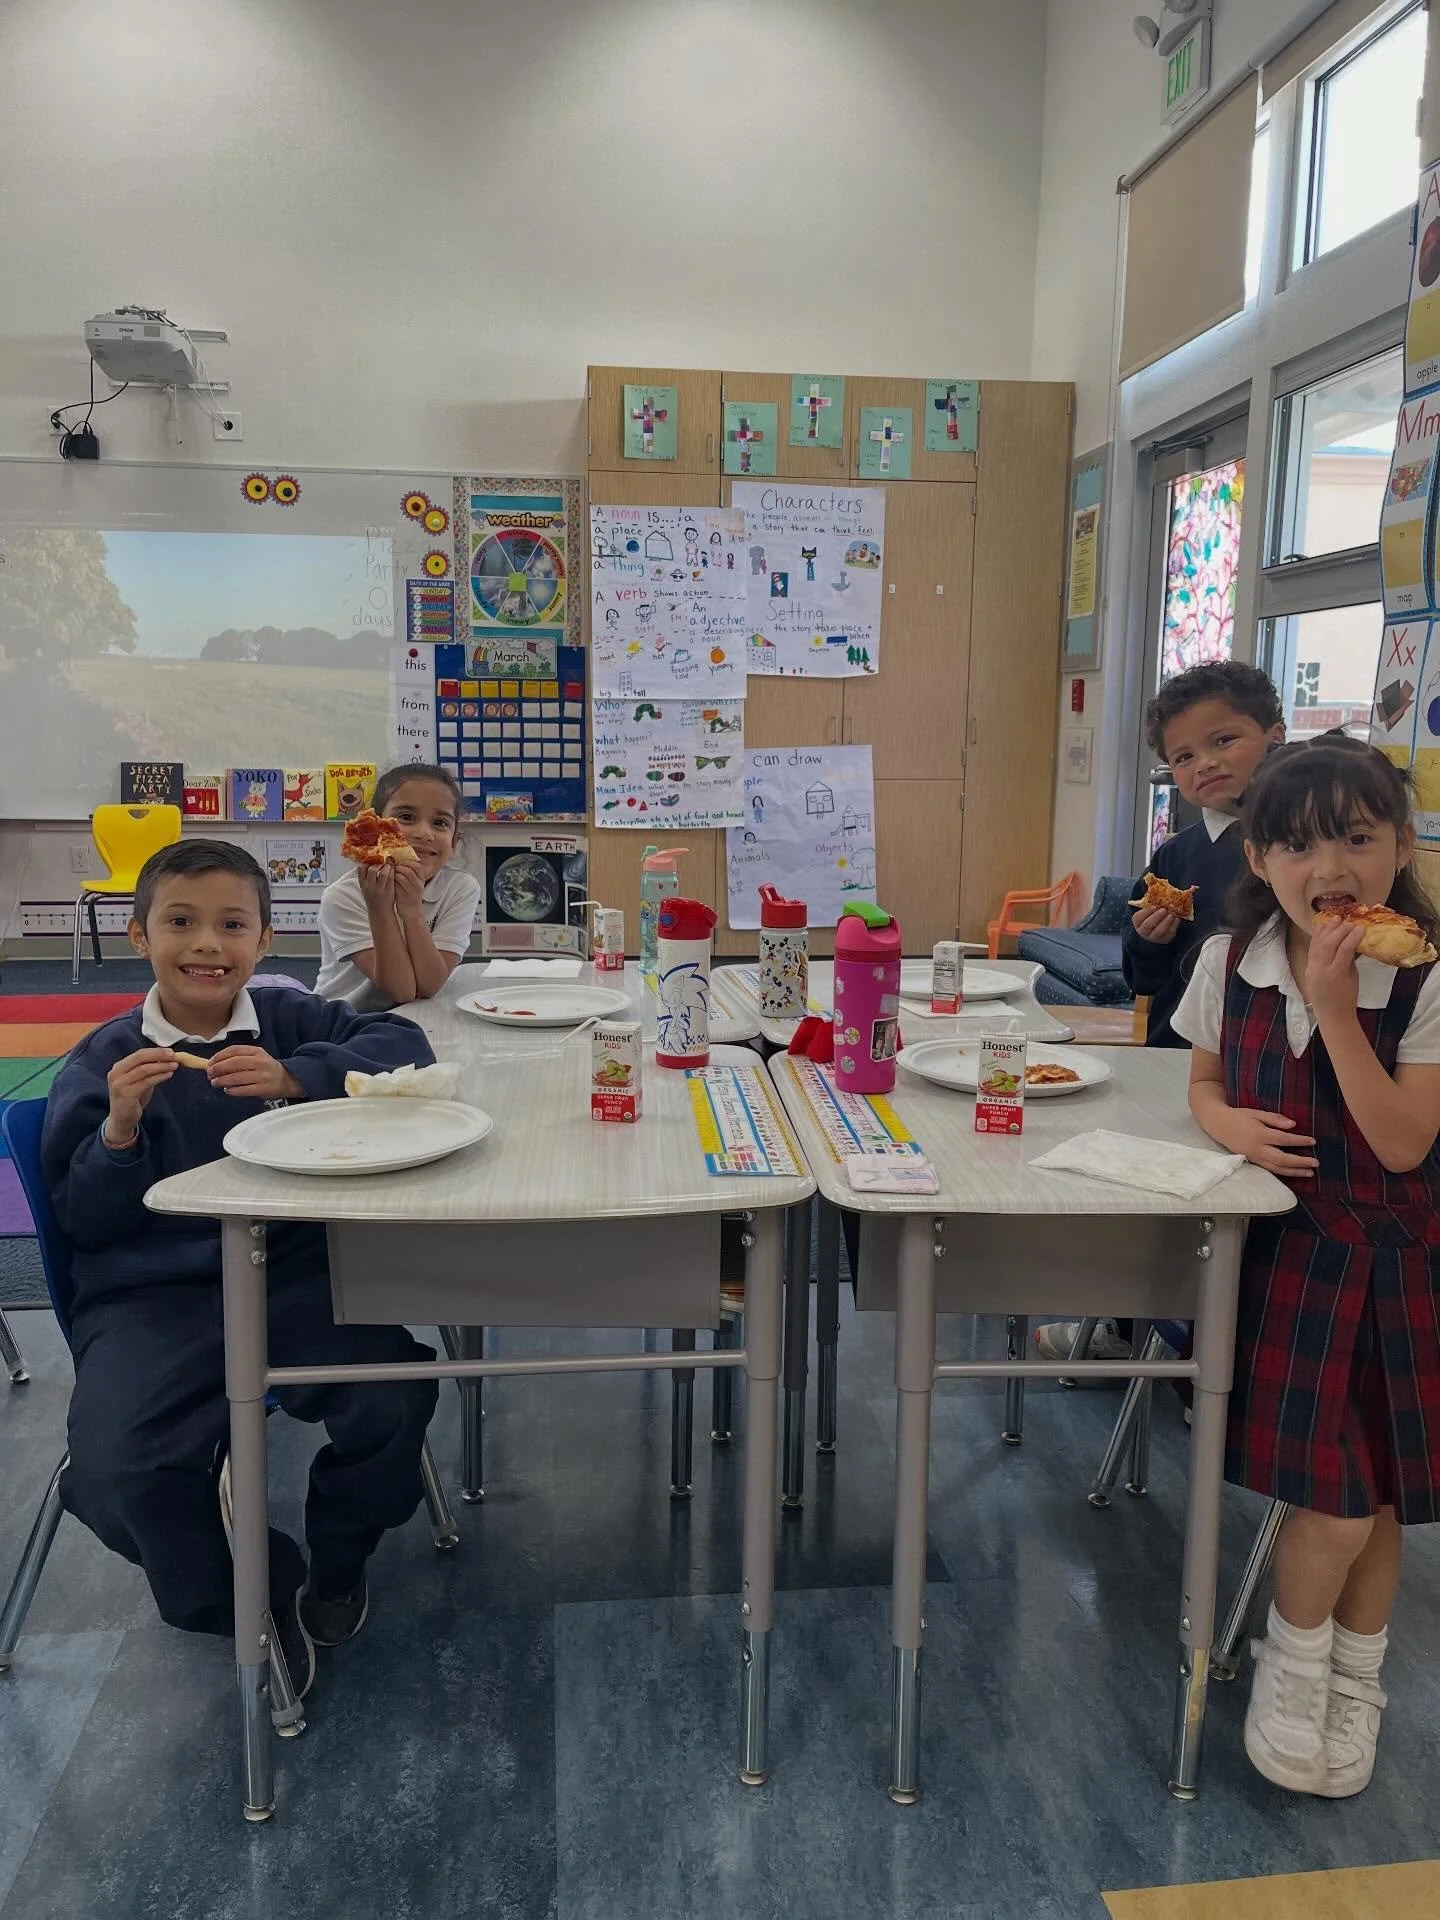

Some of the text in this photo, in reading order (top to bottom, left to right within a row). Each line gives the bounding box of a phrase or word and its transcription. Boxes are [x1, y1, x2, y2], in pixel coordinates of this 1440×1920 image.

[1166, 37, 1195, 109] EXIT
[1417, 360, 1438, 382] apple
[1398, 399, 1440, 447] Mm
[760, 489, 863, 514] Characters
[486, 512, 553, 528] weather
[596, 507, 604, 516] A
[612, 509, 640, 521] noun
[762, 511, 788, 523] people
[594, 526, 606, 534] a
[612, 527, 643, 540] place
[765, 523, 784, 534] story
[791, 524, 808, 532] that
[594, 556, 645, 577] a thing
[548, 592, 563, 611] sunny
[596, 591, 604, 604] A
[616, 588, 646, 600] verb
[693, 602, 706, 612] An
[767, 600, 824, 625] Setting
[690, 613, 745, 630] adjective
[704, 628, 745, 637] describing
[775, 624, 786, 632] the
[792, 625, 811, 633] story
[816, 623, 837, 632] takes
[841, 624, 862, 636] place
[1386, 627, 1417, 668] Xx
[404, 658, 427, 671] this
[493, 653, 530, 663] March
[708, 664, 734, 677] yummy
[633, 688, 646, 697] tall
[400, 698, 430, 712] from
[397, 726, 430, 738] there
[704, 740, 719, 749] End
[788, 749, 822, 766] draw
[130, 765, 174, 775] SECRET
[136, 775, 170, 784] PIZZA
[234, 771, 278, 783] YOKO
[133, 784, 171, 794] PARTY
[619, 784, 644, 794] Idea
[610, 818, 648, 826] caterpillar
[684, 812, 693, 820] of
[694, 811, 710, 820] food
[712, 811, 724, 819] and
[535, 842, 576, 852] EARTH
[815, 842, 854, 856] Objects
[730, 850, 771, 865] Animals
[594, 1031, 632, 1043] Honest
[982, 1041, 1024, 1052] Honest
